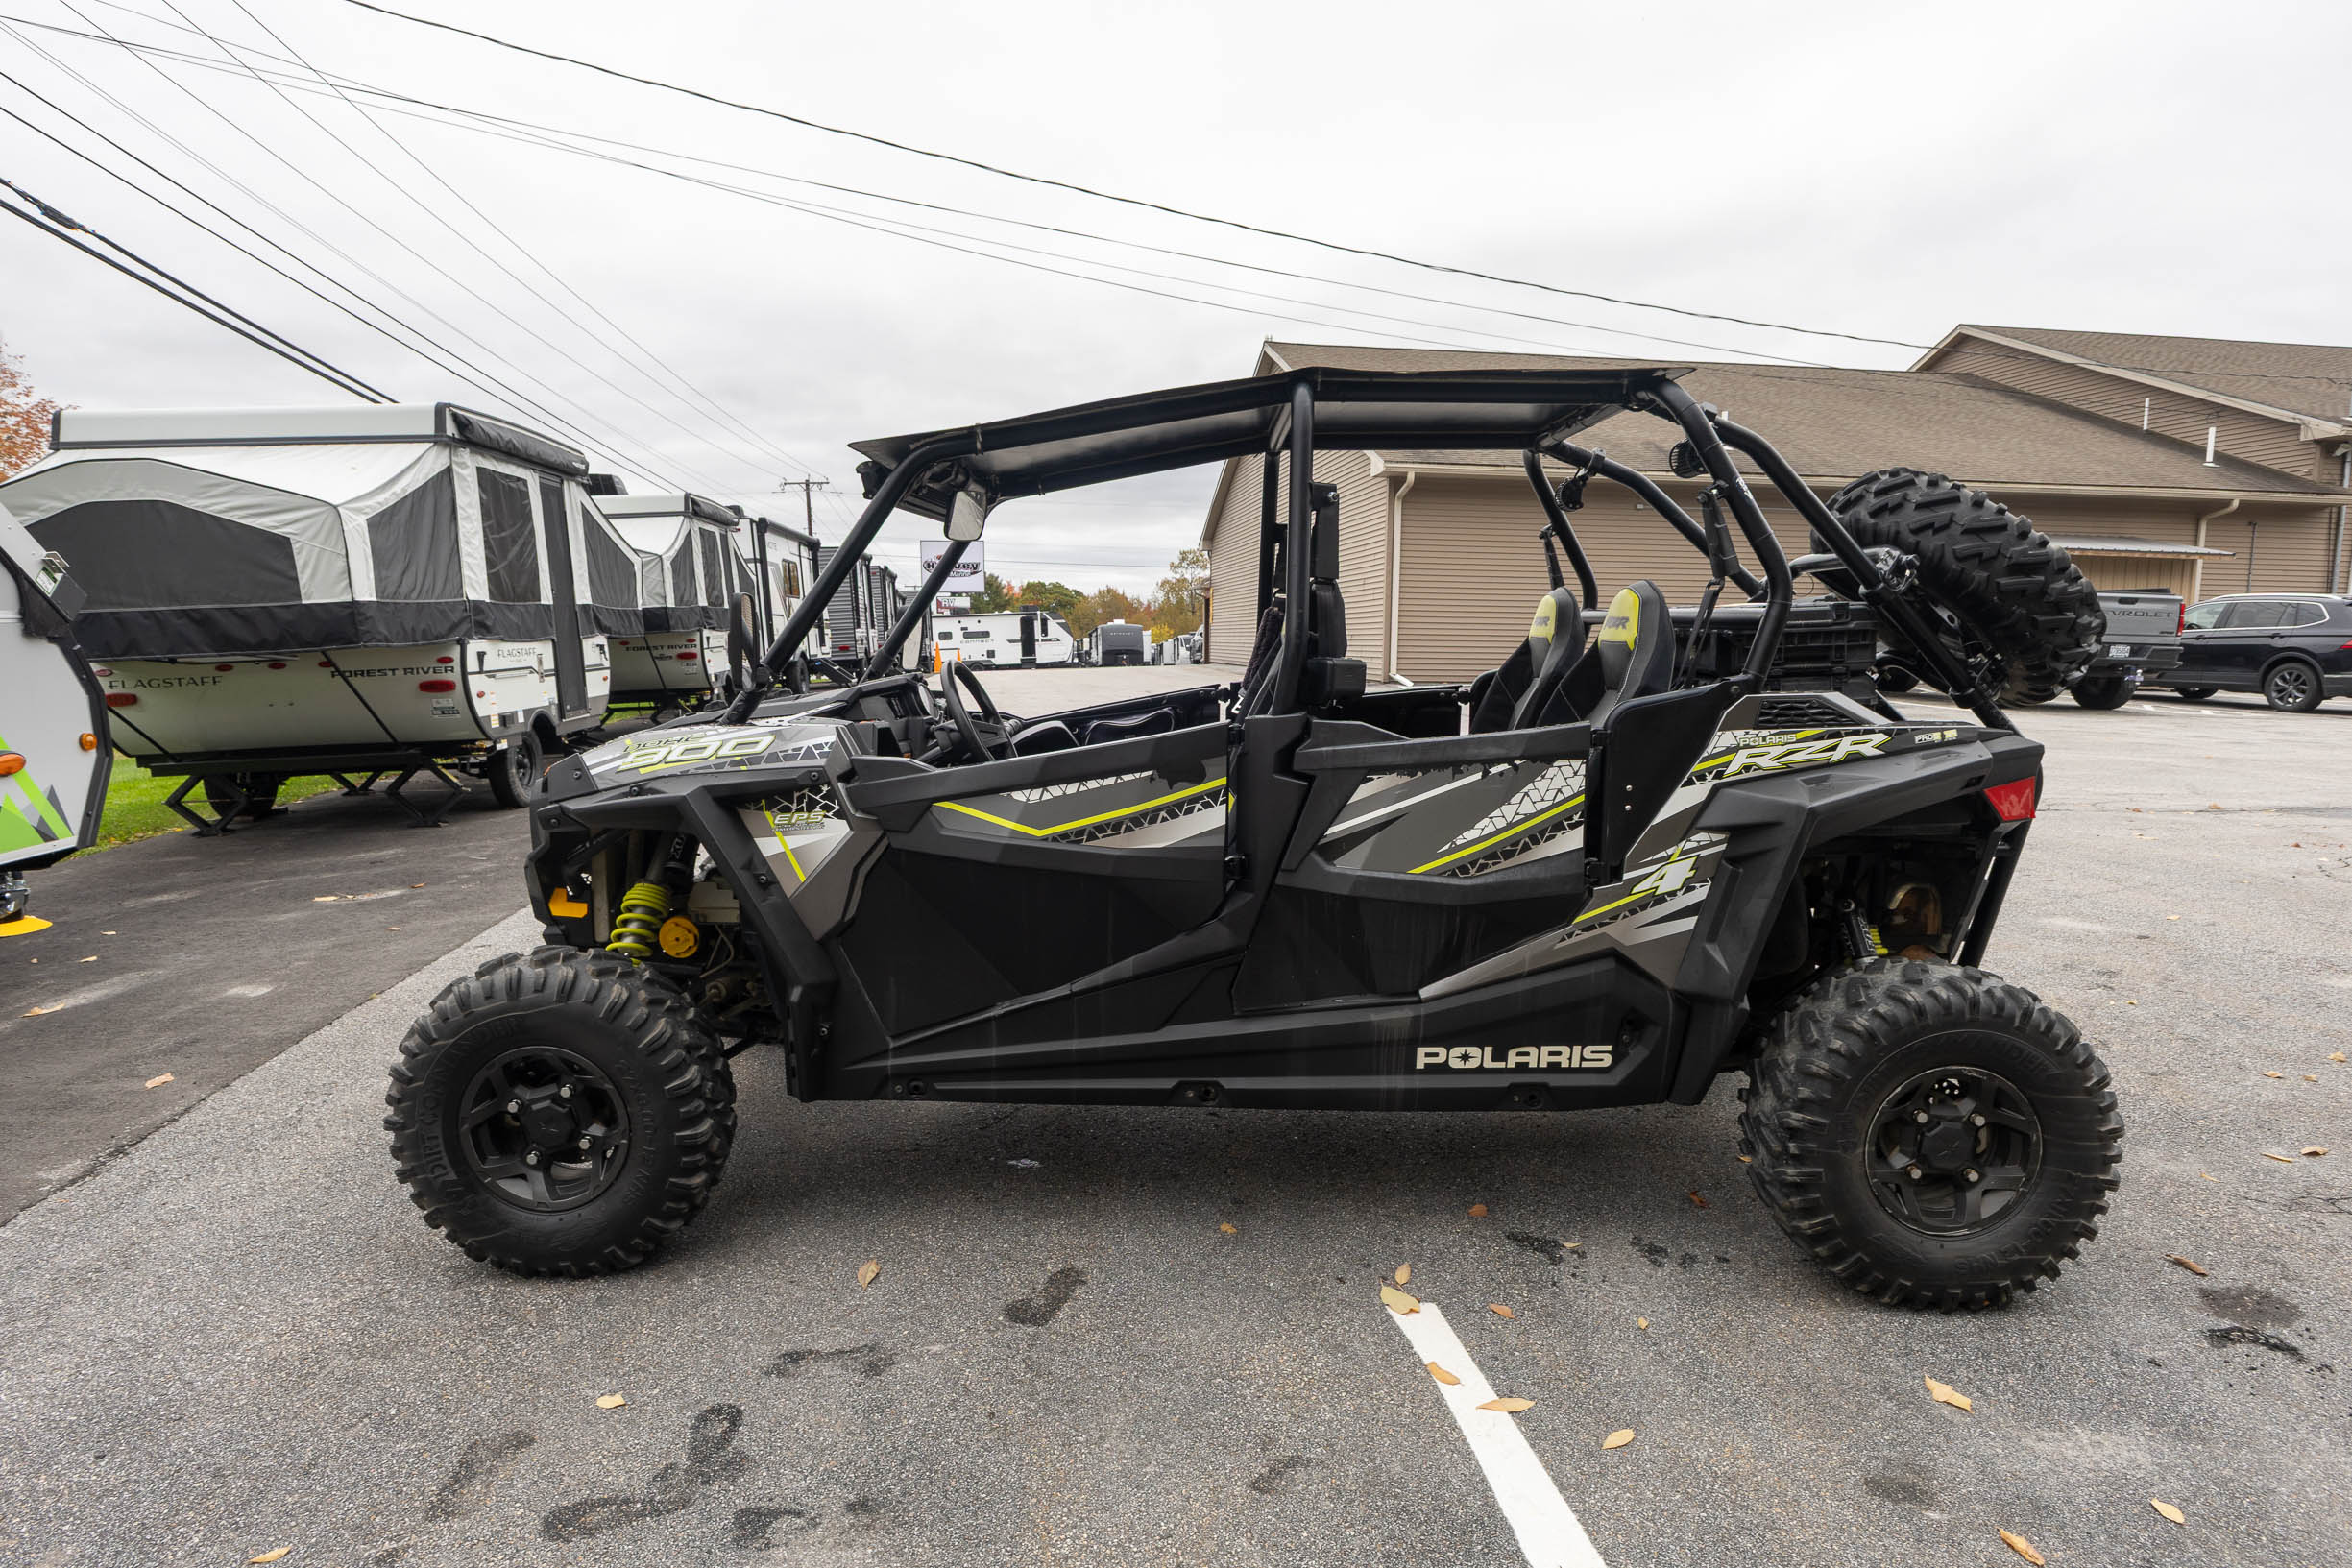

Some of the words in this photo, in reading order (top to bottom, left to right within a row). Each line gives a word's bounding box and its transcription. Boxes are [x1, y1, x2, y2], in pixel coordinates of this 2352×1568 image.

[497, 647, 538, 659] FLAGSTAFF
[330, 666, 399, 679] FOREST
[403, 664, 455, 677] RIVER
[108, 674, 224, 690] FLAGSTAFF
[1739, 733, 1797, 747] POLARIS
[616, 735, 776, 774] 900
[1723, 733, 1892, 777] RZR
[774, 810, 826, 824] EPS
[1416, 1045, 1612, 1070] POLARIS
